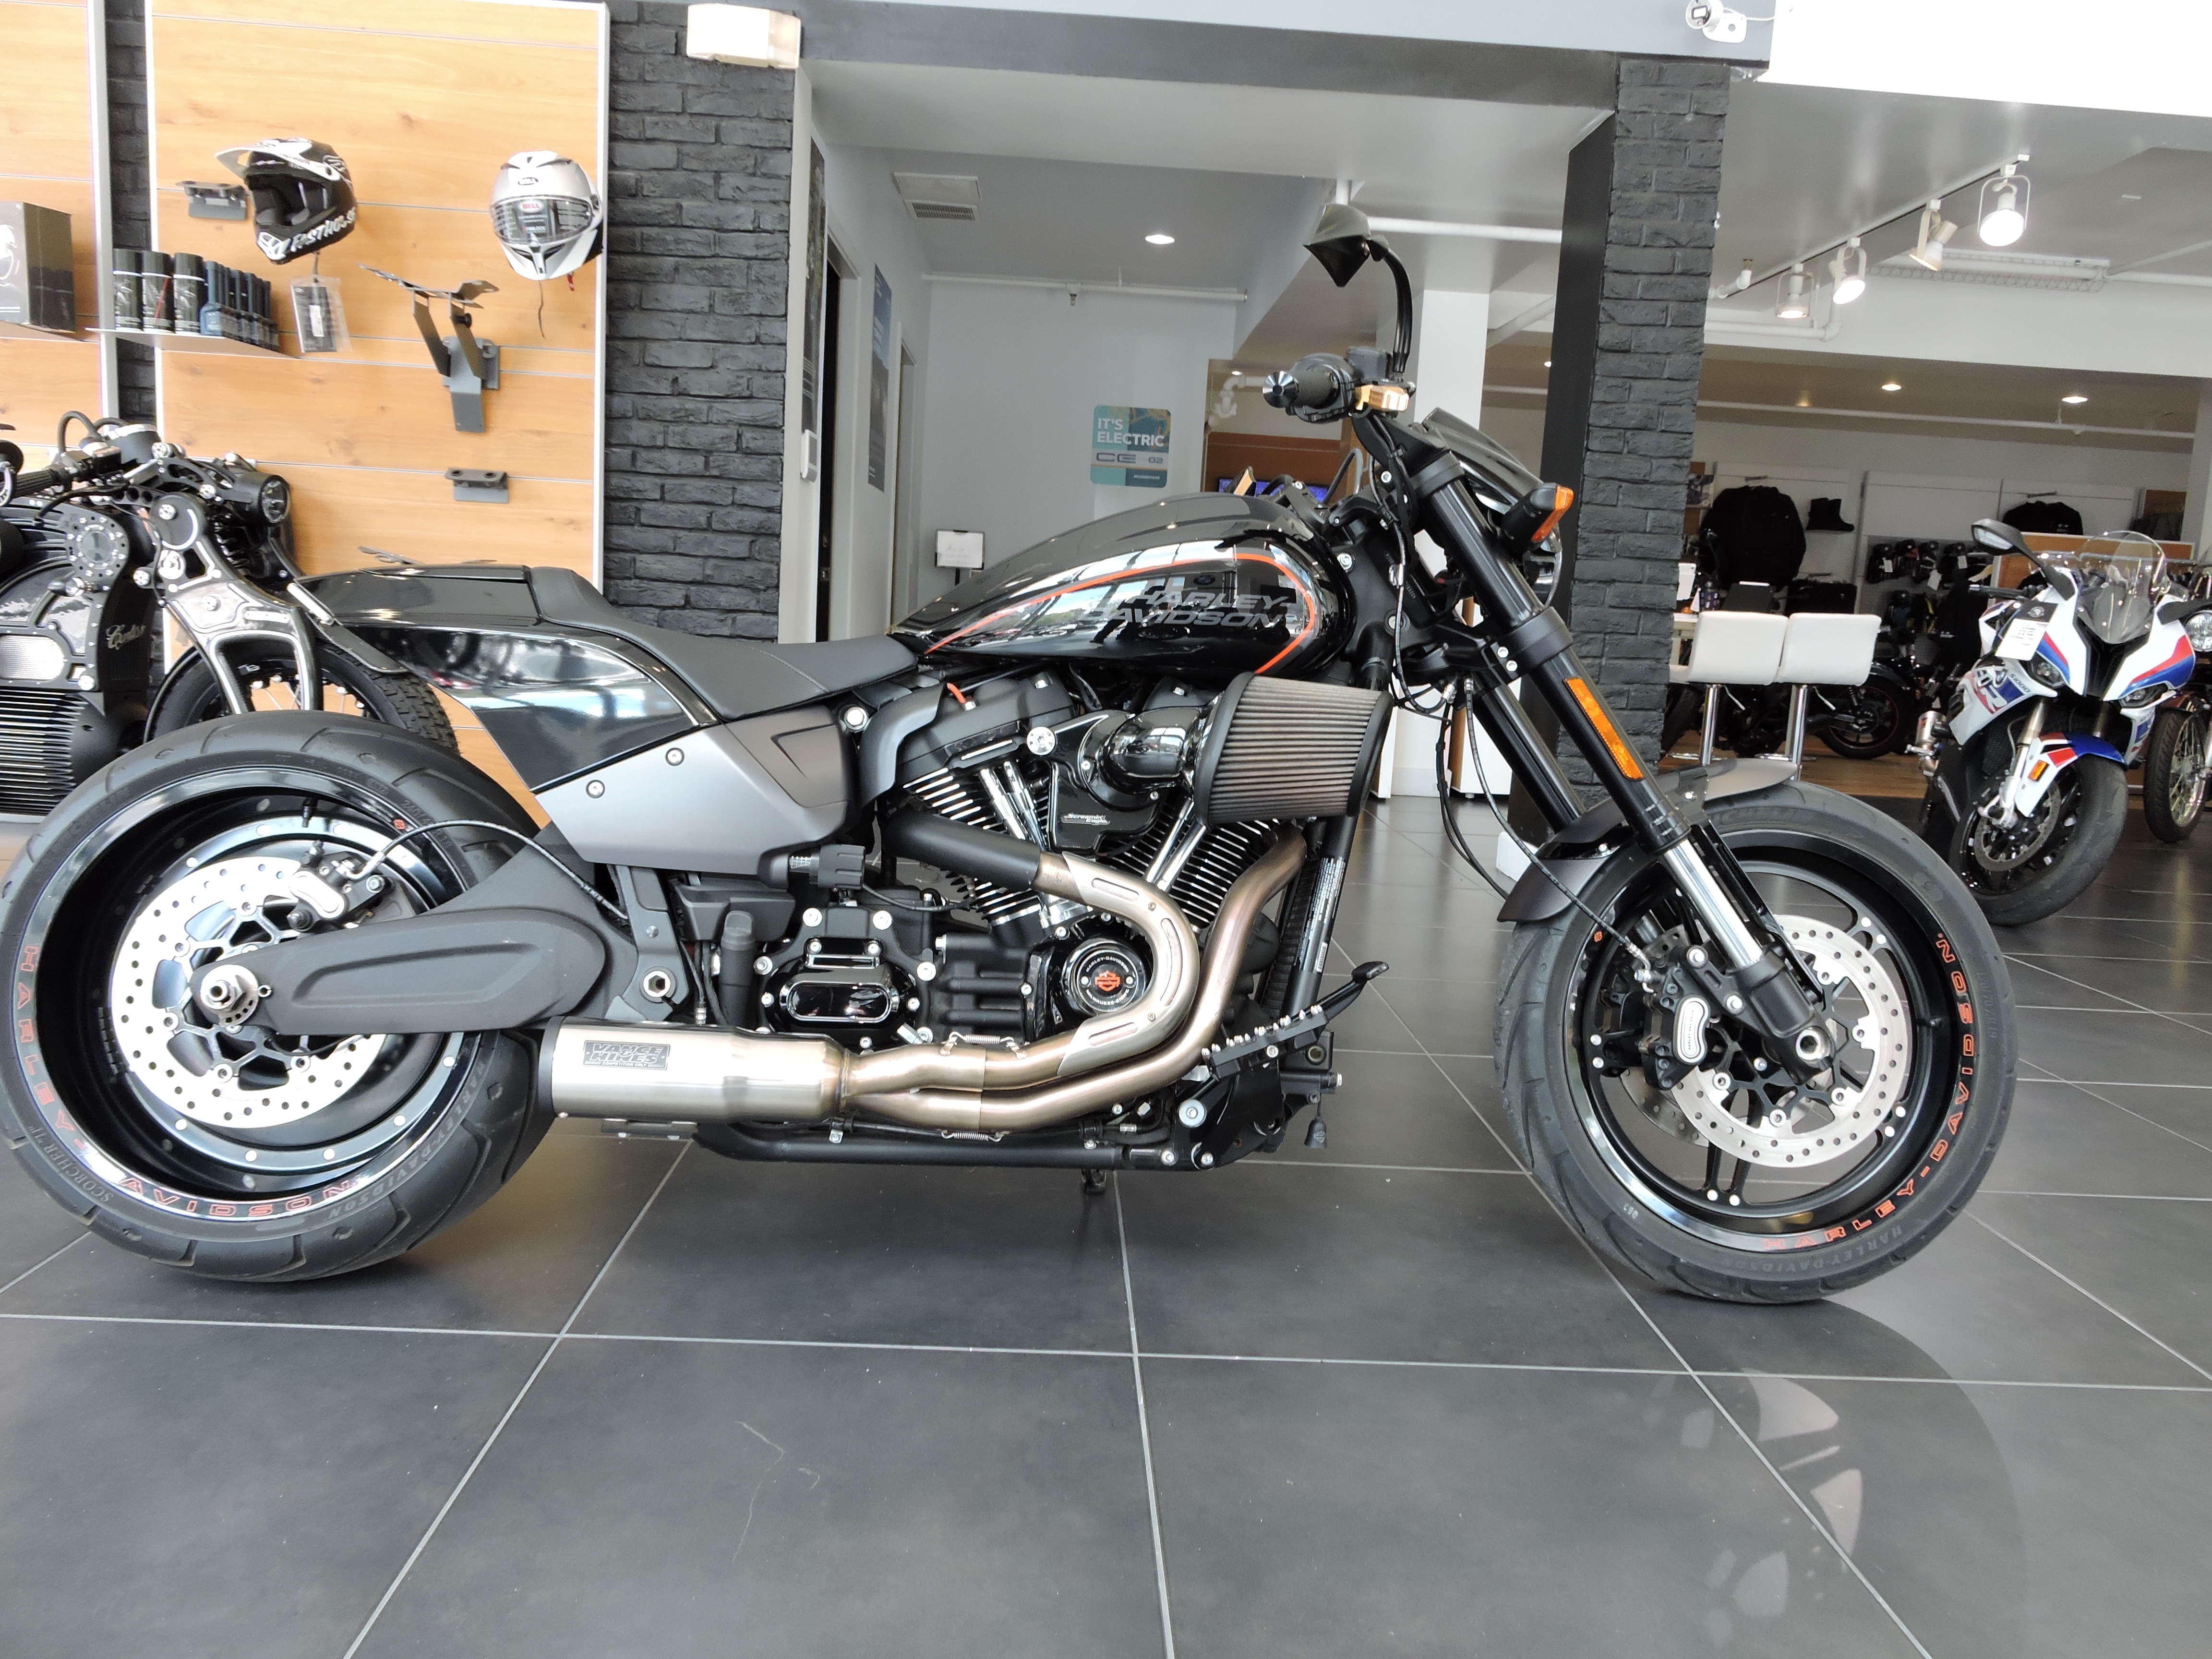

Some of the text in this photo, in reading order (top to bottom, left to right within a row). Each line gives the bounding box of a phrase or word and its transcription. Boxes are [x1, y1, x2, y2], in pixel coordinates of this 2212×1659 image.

[1098, 418, 1123, 431] IT'S
[1097, 432, 1165, 446] ELECTRIC
[1096, 453, 1137, 464] CE
[1077, 607, 1285, 628] DAVIDSON
[2009, 673, 2031, 693] S1000
[592, 1043, 664, 1055] VANCE
[589, 1052, 659, 1064] HINES
